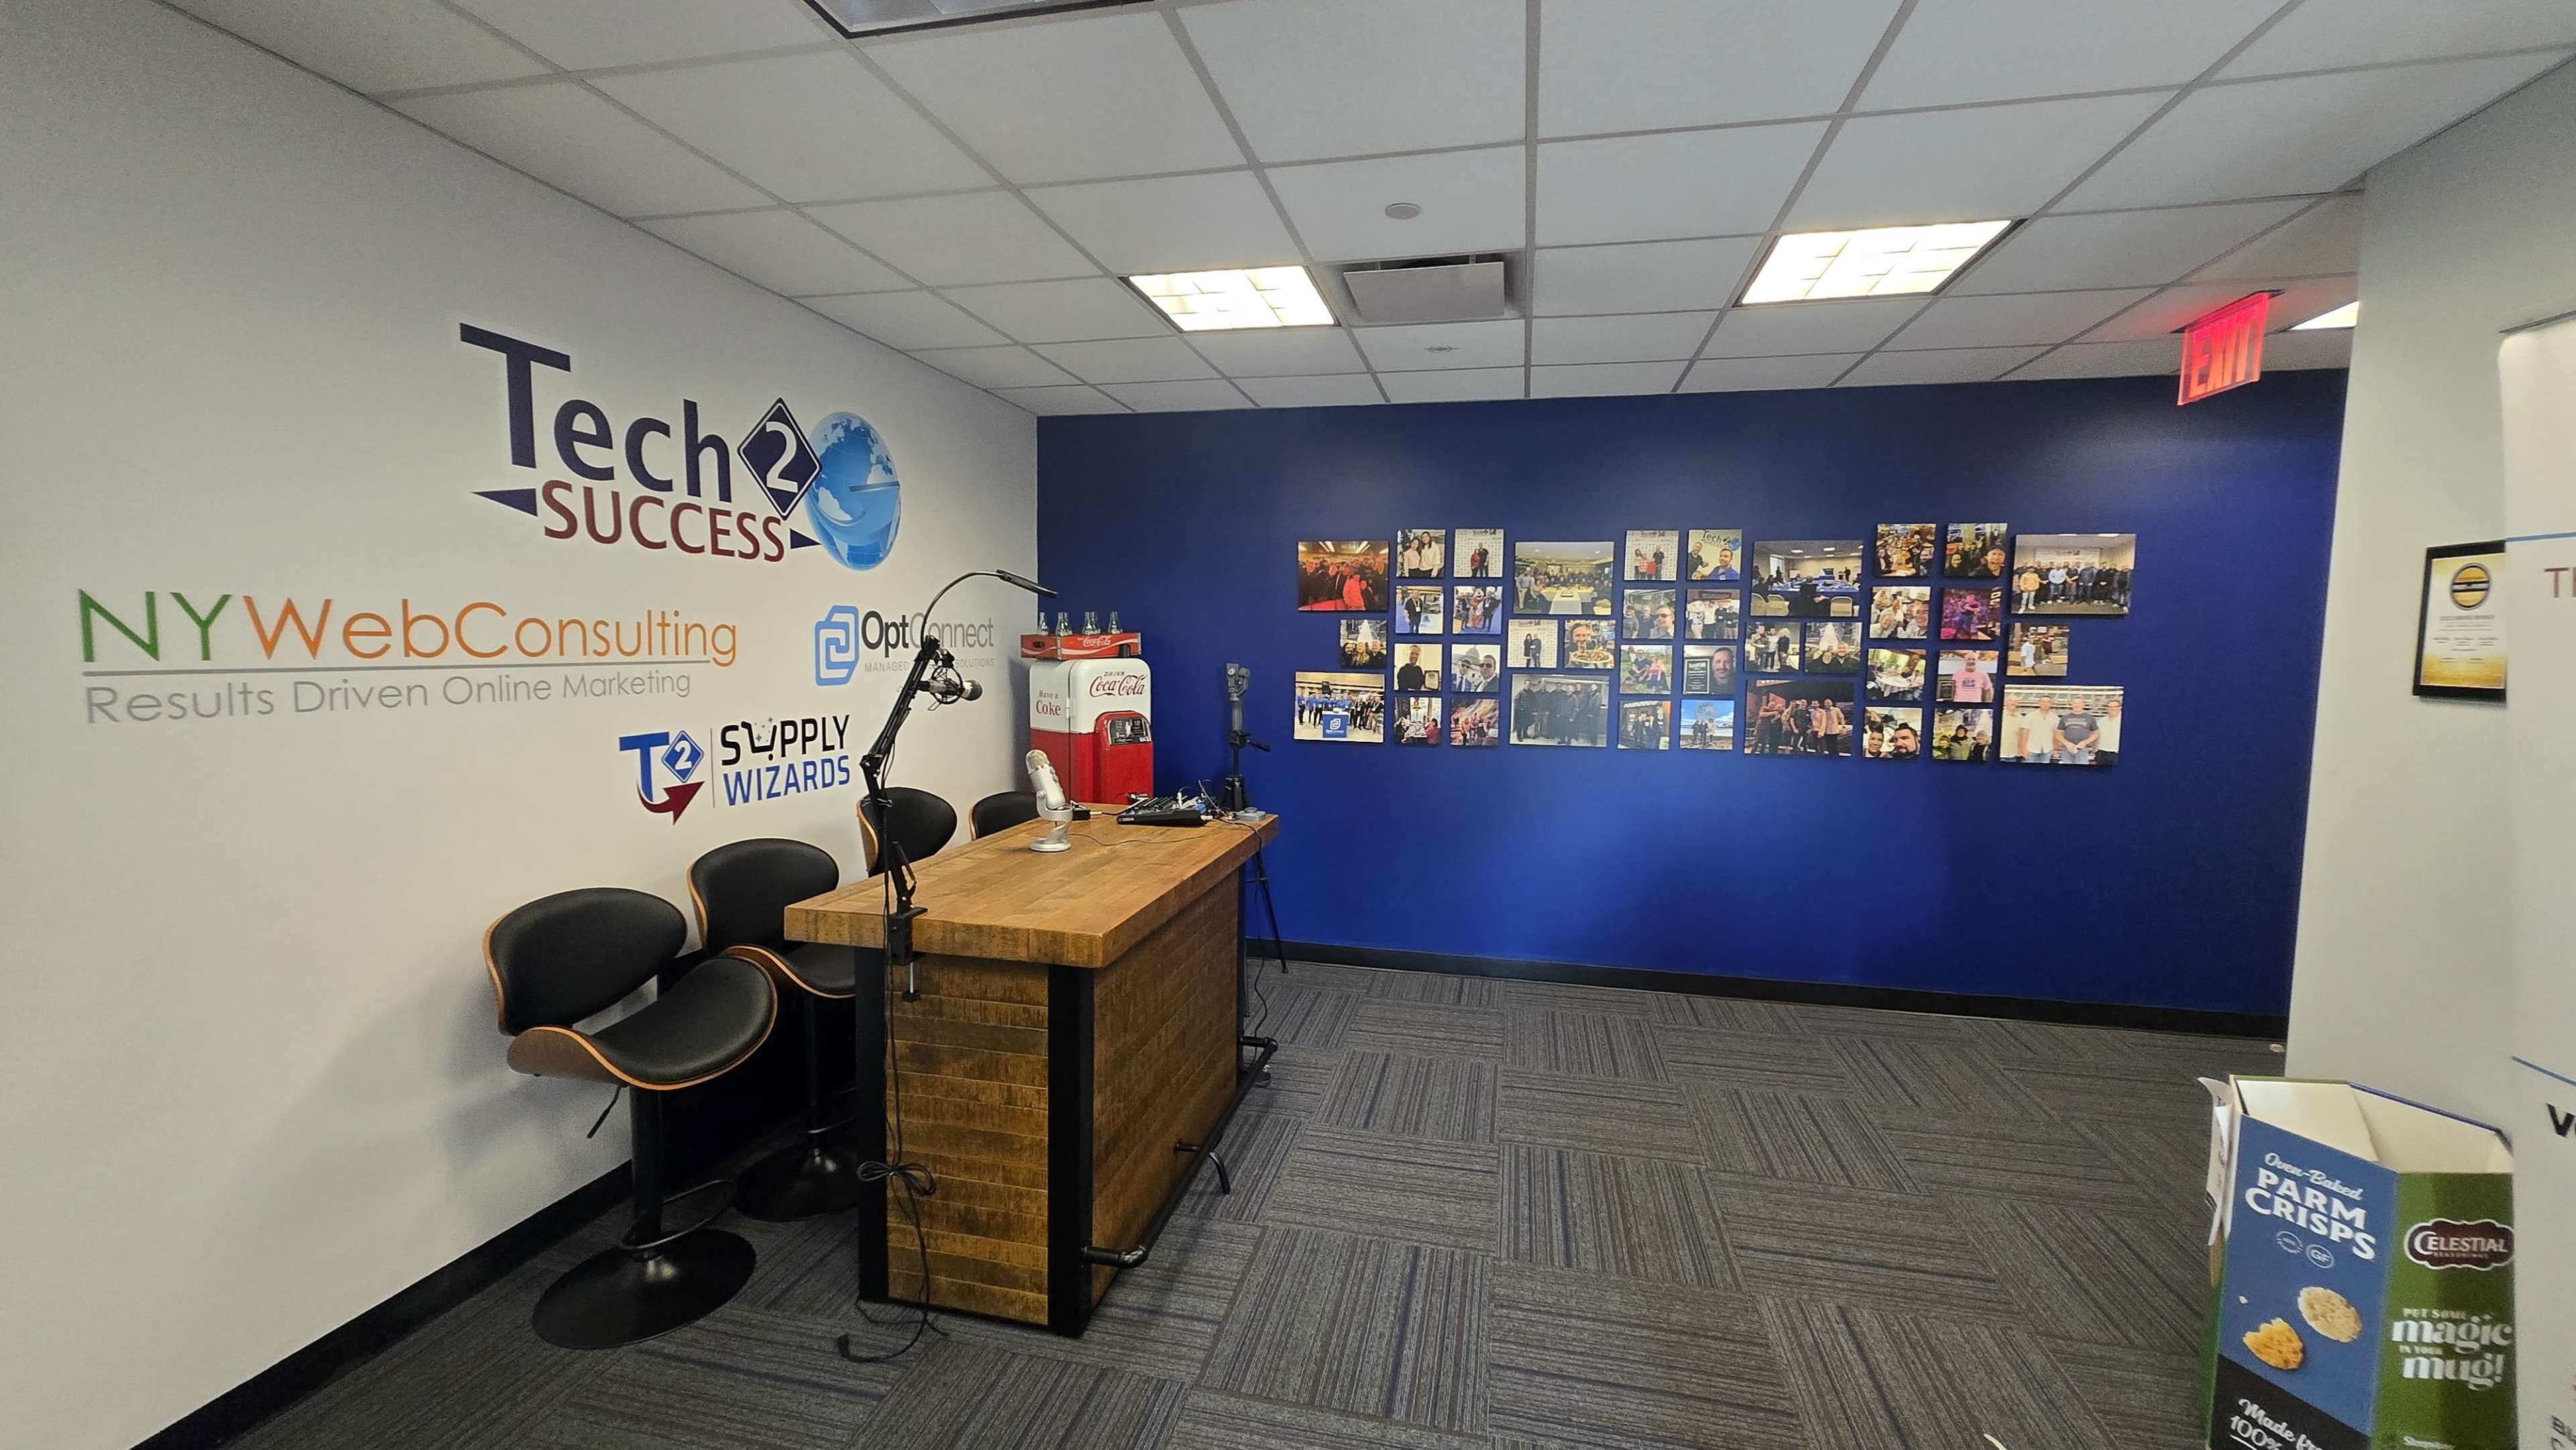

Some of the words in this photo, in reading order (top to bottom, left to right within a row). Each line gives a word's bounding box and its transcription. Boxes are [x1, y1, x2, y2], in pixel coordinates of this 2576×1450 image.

[2189, 304, 2257, 397] EXIT
[460, 323, 731, 503] Tech
[541, 480, 785, 562] SUCCESS
[2544, 567, 2576, 598] T
[78, 589, 737, 667] NYWebConsulting
[861, 610, 994, 658] OptConnect
[1083, 634, 1112, 647] Coca-Cola
[864, 661, 909, 673] MANAGED
[955, 657, 995, 669] SOLUTIONS
[1089, 675, 1147, 698] Coca-Cola
[86, 682, 275, 724] Results
[293, 679, 428, 713] Driven
[443, 674, 551, 705] Online
[562, 669, 691, 698] Marketing
[1036, 700, 1061, 716] Coke
[1038, 689, 1053, 699] Have
[720, 714, 850, 766] SUPPLY
[723, 755, 851, 806] WIZARDS
[2545, 1102, 2576, 1138] V
[2257, 1167, 2367, 1230] PARM
[2264, 1152, 2364, 1201] Oven-Baked
[2245, 1187, 2377, 1260] CRISPS
[2415, 1231, 2508, 1255] CELESTIAL
[2310, 1249, 2330, 1262] GF
[2392, 1315, 2512, 1354] magic
[2402, 1352, 2505, 1390] mug!
[2239, 1398, 2296, 1442] Made
